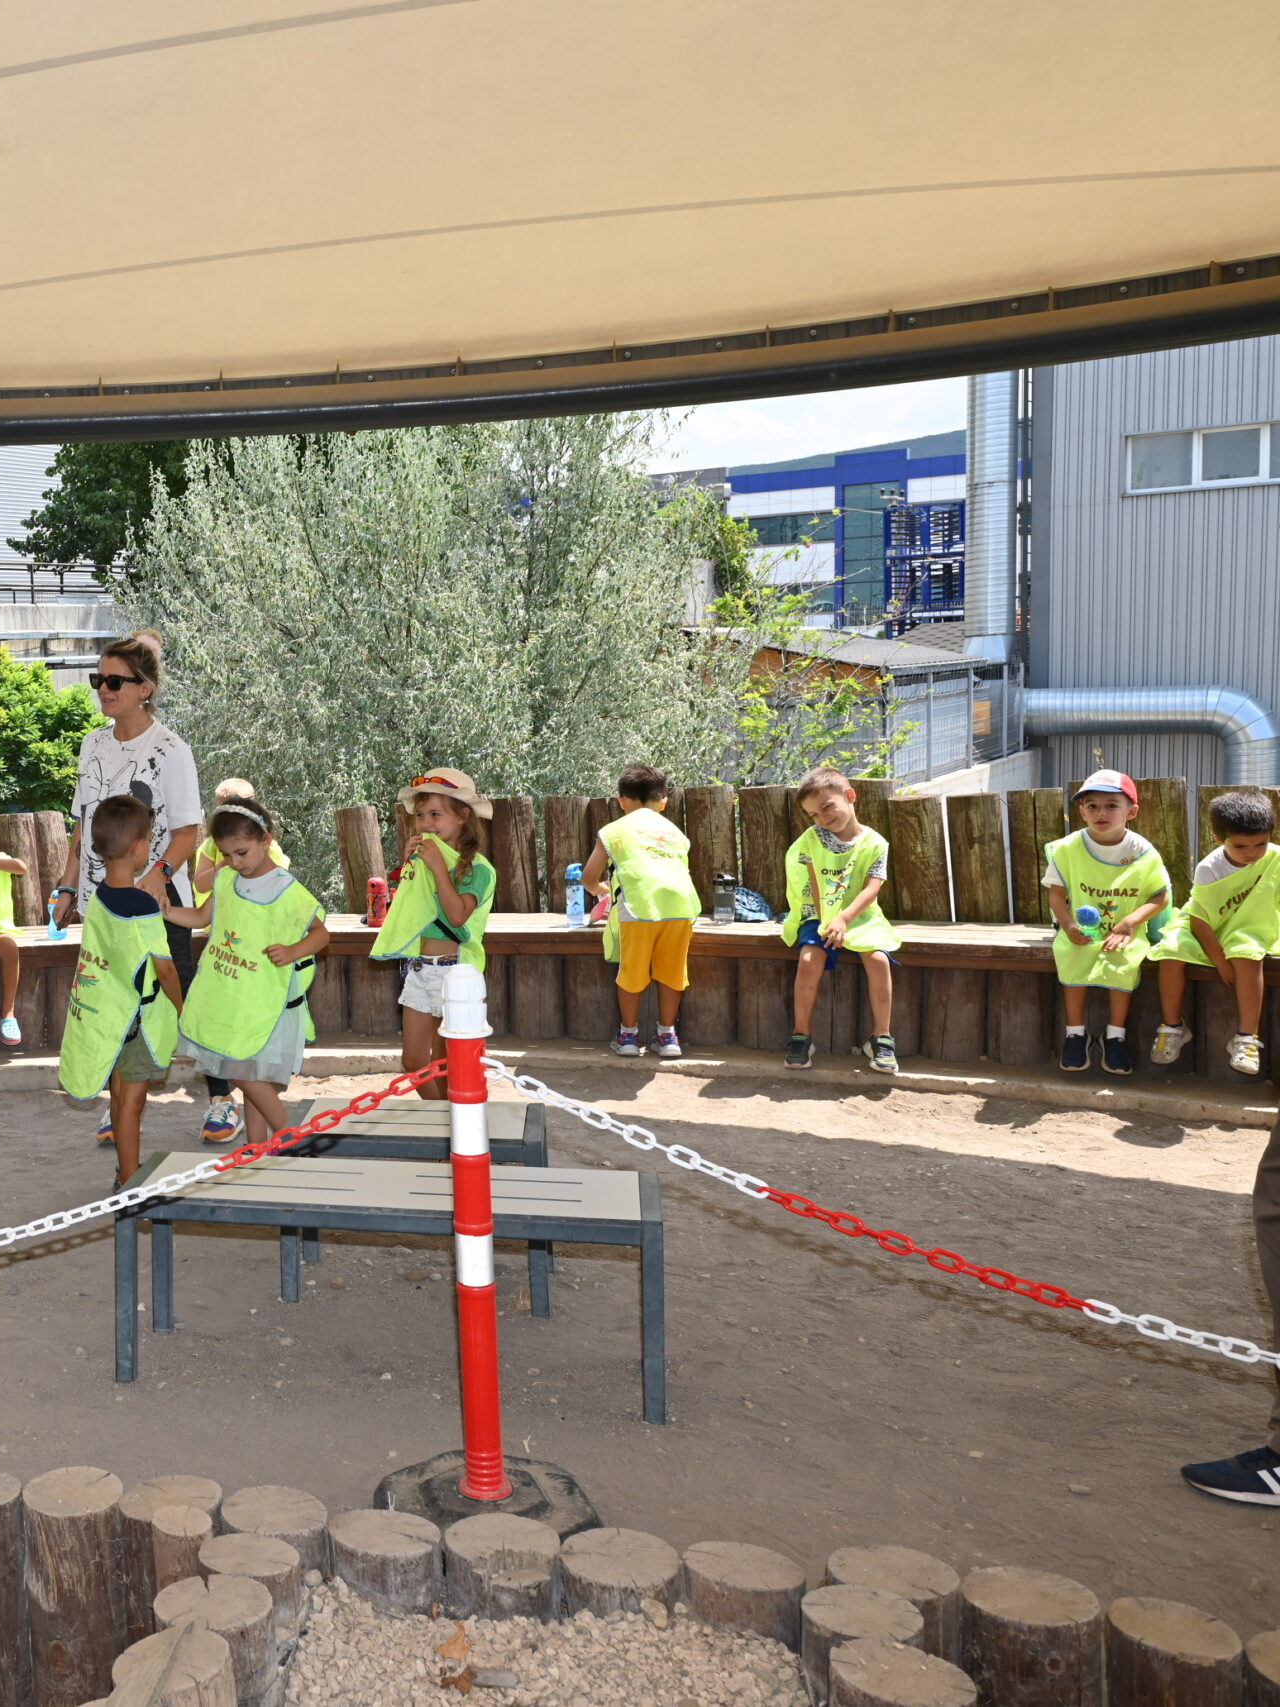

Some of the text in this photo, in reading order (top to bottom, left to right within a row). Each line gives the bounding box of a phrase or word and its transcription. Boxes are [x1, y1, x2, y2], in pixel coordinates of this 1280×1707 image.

[1080, 882, 1139, 898] OYUNBAZ
[1100, 922, 1116, 932] KU
[79, 947, 110, 971] NBAZ
